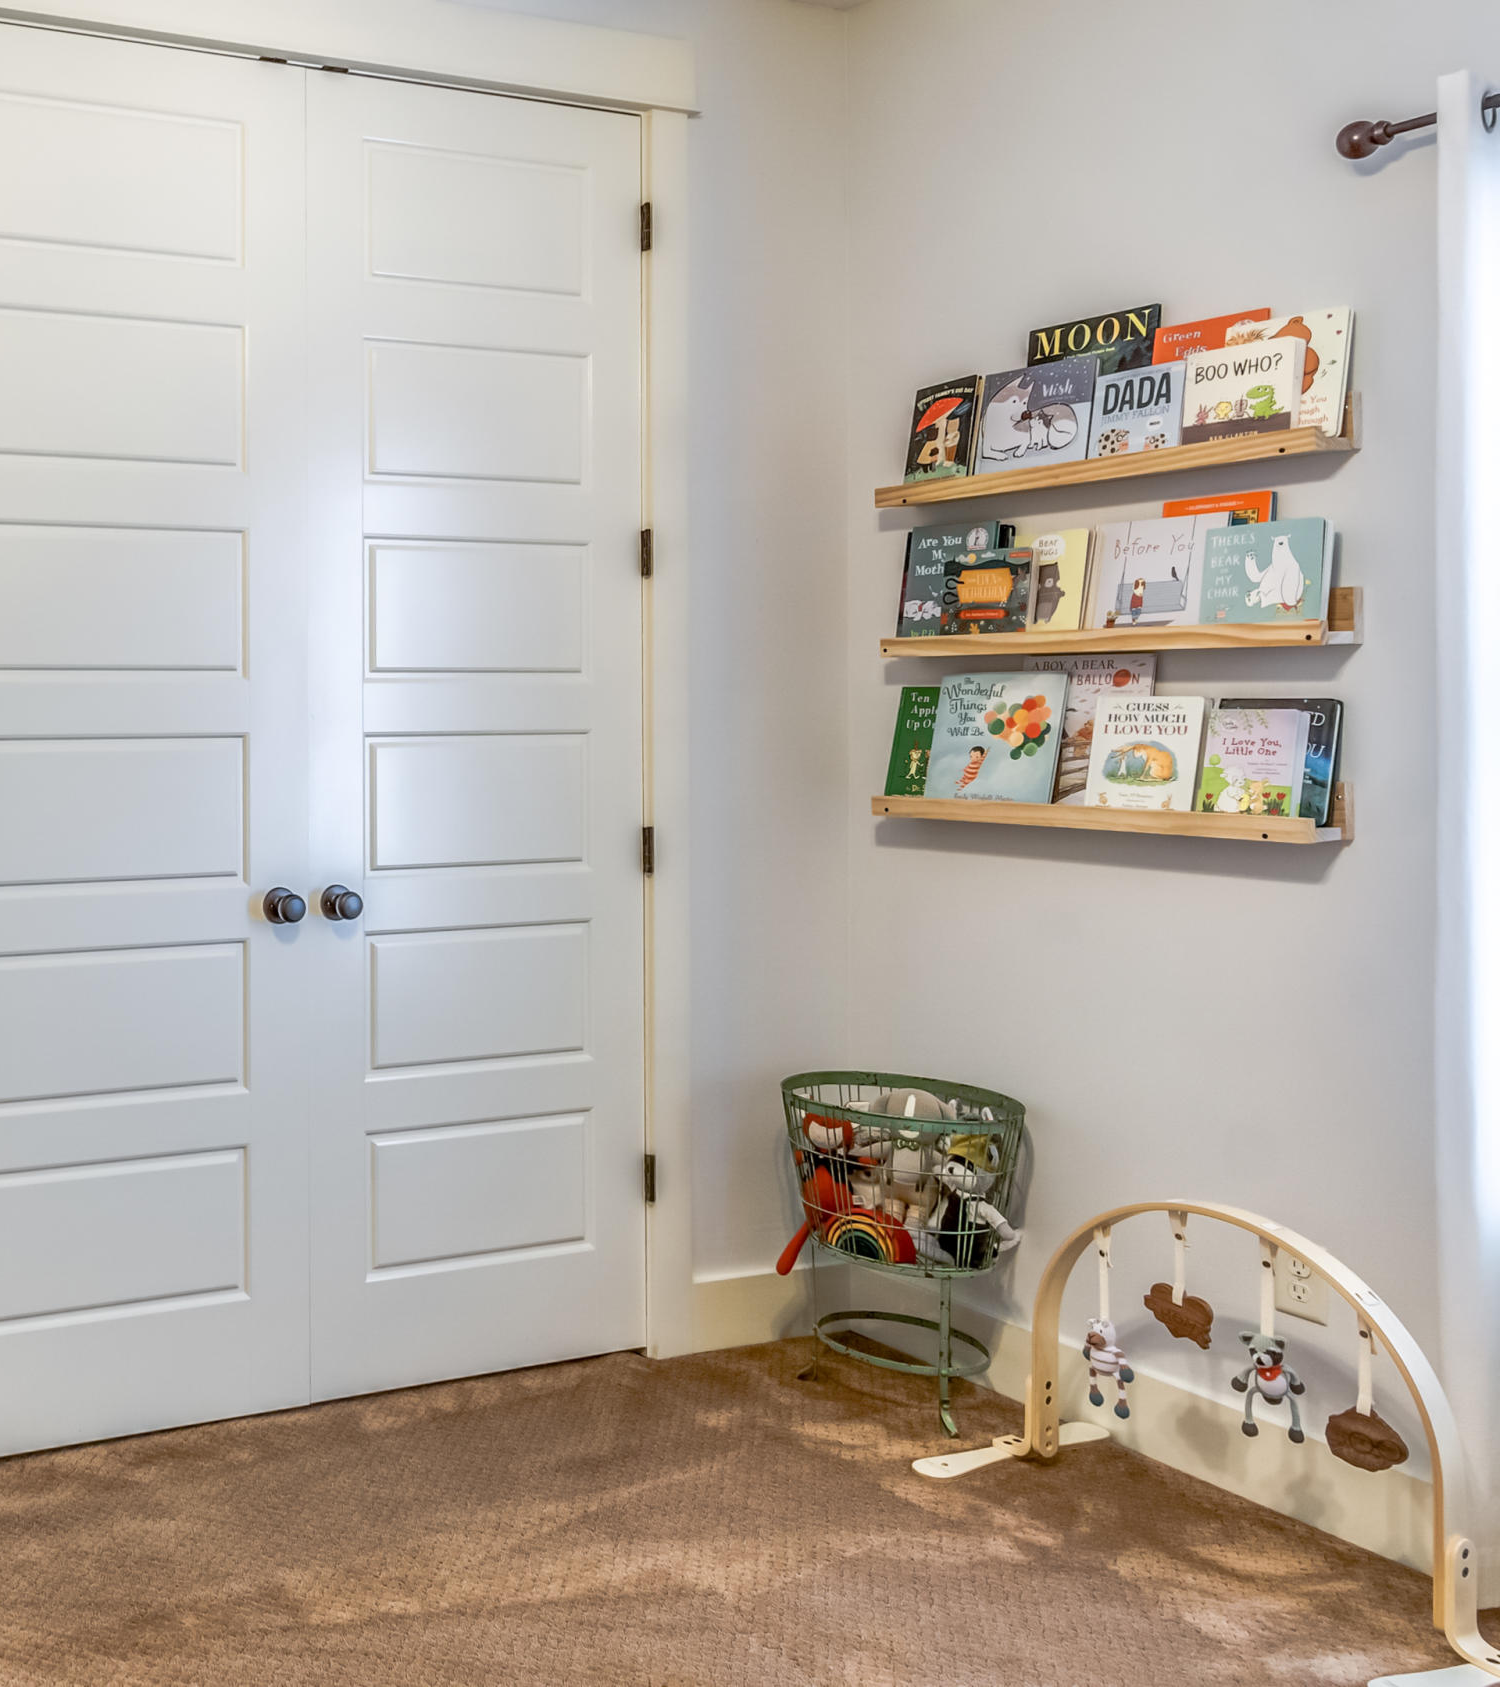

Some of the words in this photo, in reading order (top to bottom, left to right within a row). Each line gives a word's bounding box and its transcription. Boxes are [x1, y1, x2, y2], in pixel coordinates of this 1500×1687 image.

[1033, 308, 1153, 360] MOON
[1163, 330, 1202, 343] Green
[1195, 363, 1228, 384] BOO
[1233, 352, 1283, 376] WHO?
[1042, 378, 1074, 398] Wish
[1102, 372, 1171, 416] DADA
[918, 538, 939, 549] Are
[942, 535, 962, 546] You
[1114, 537, 1160, 560] Before
[1170, 533, 1195, 555] You
[1211, 554, 1240, 568] BEAR
[915, 563, 945, 576] Moth
[1215, 574, 1232, 585] MY
[1207, 586, 1239, 599] CHAIR
[1073, 660, 1079, 670] A
[910, 692, 930, 703] Ten
[942, 682, 1007, 700] Wonderful
[910, 705, 937, 717] Appl
[949, 698, 987, 714] Things
[1126, 703, 1169, 712] GUESS
[958, 712, 976, 725] You
[1108, 713, 1140, 723] HOW
[1144, 714, 1186, 723] MUCH
[906, 719, 920, 731] Up
[923, 719, 934, 729] O
[1104, 724, 1109, 734] I
[1114, 724, 1152, 735] LOVE
[1156, 725, 1188, 735] YOU
[947, 727, 969, 737] Will
[970, 727, 985, 736] Be
[1222, 737, 1227, 746] I
[1231, 737, 1256, 746] Love
[1225, 746, 1253, 756] Little
[1257, 748, 1277, 756] One
